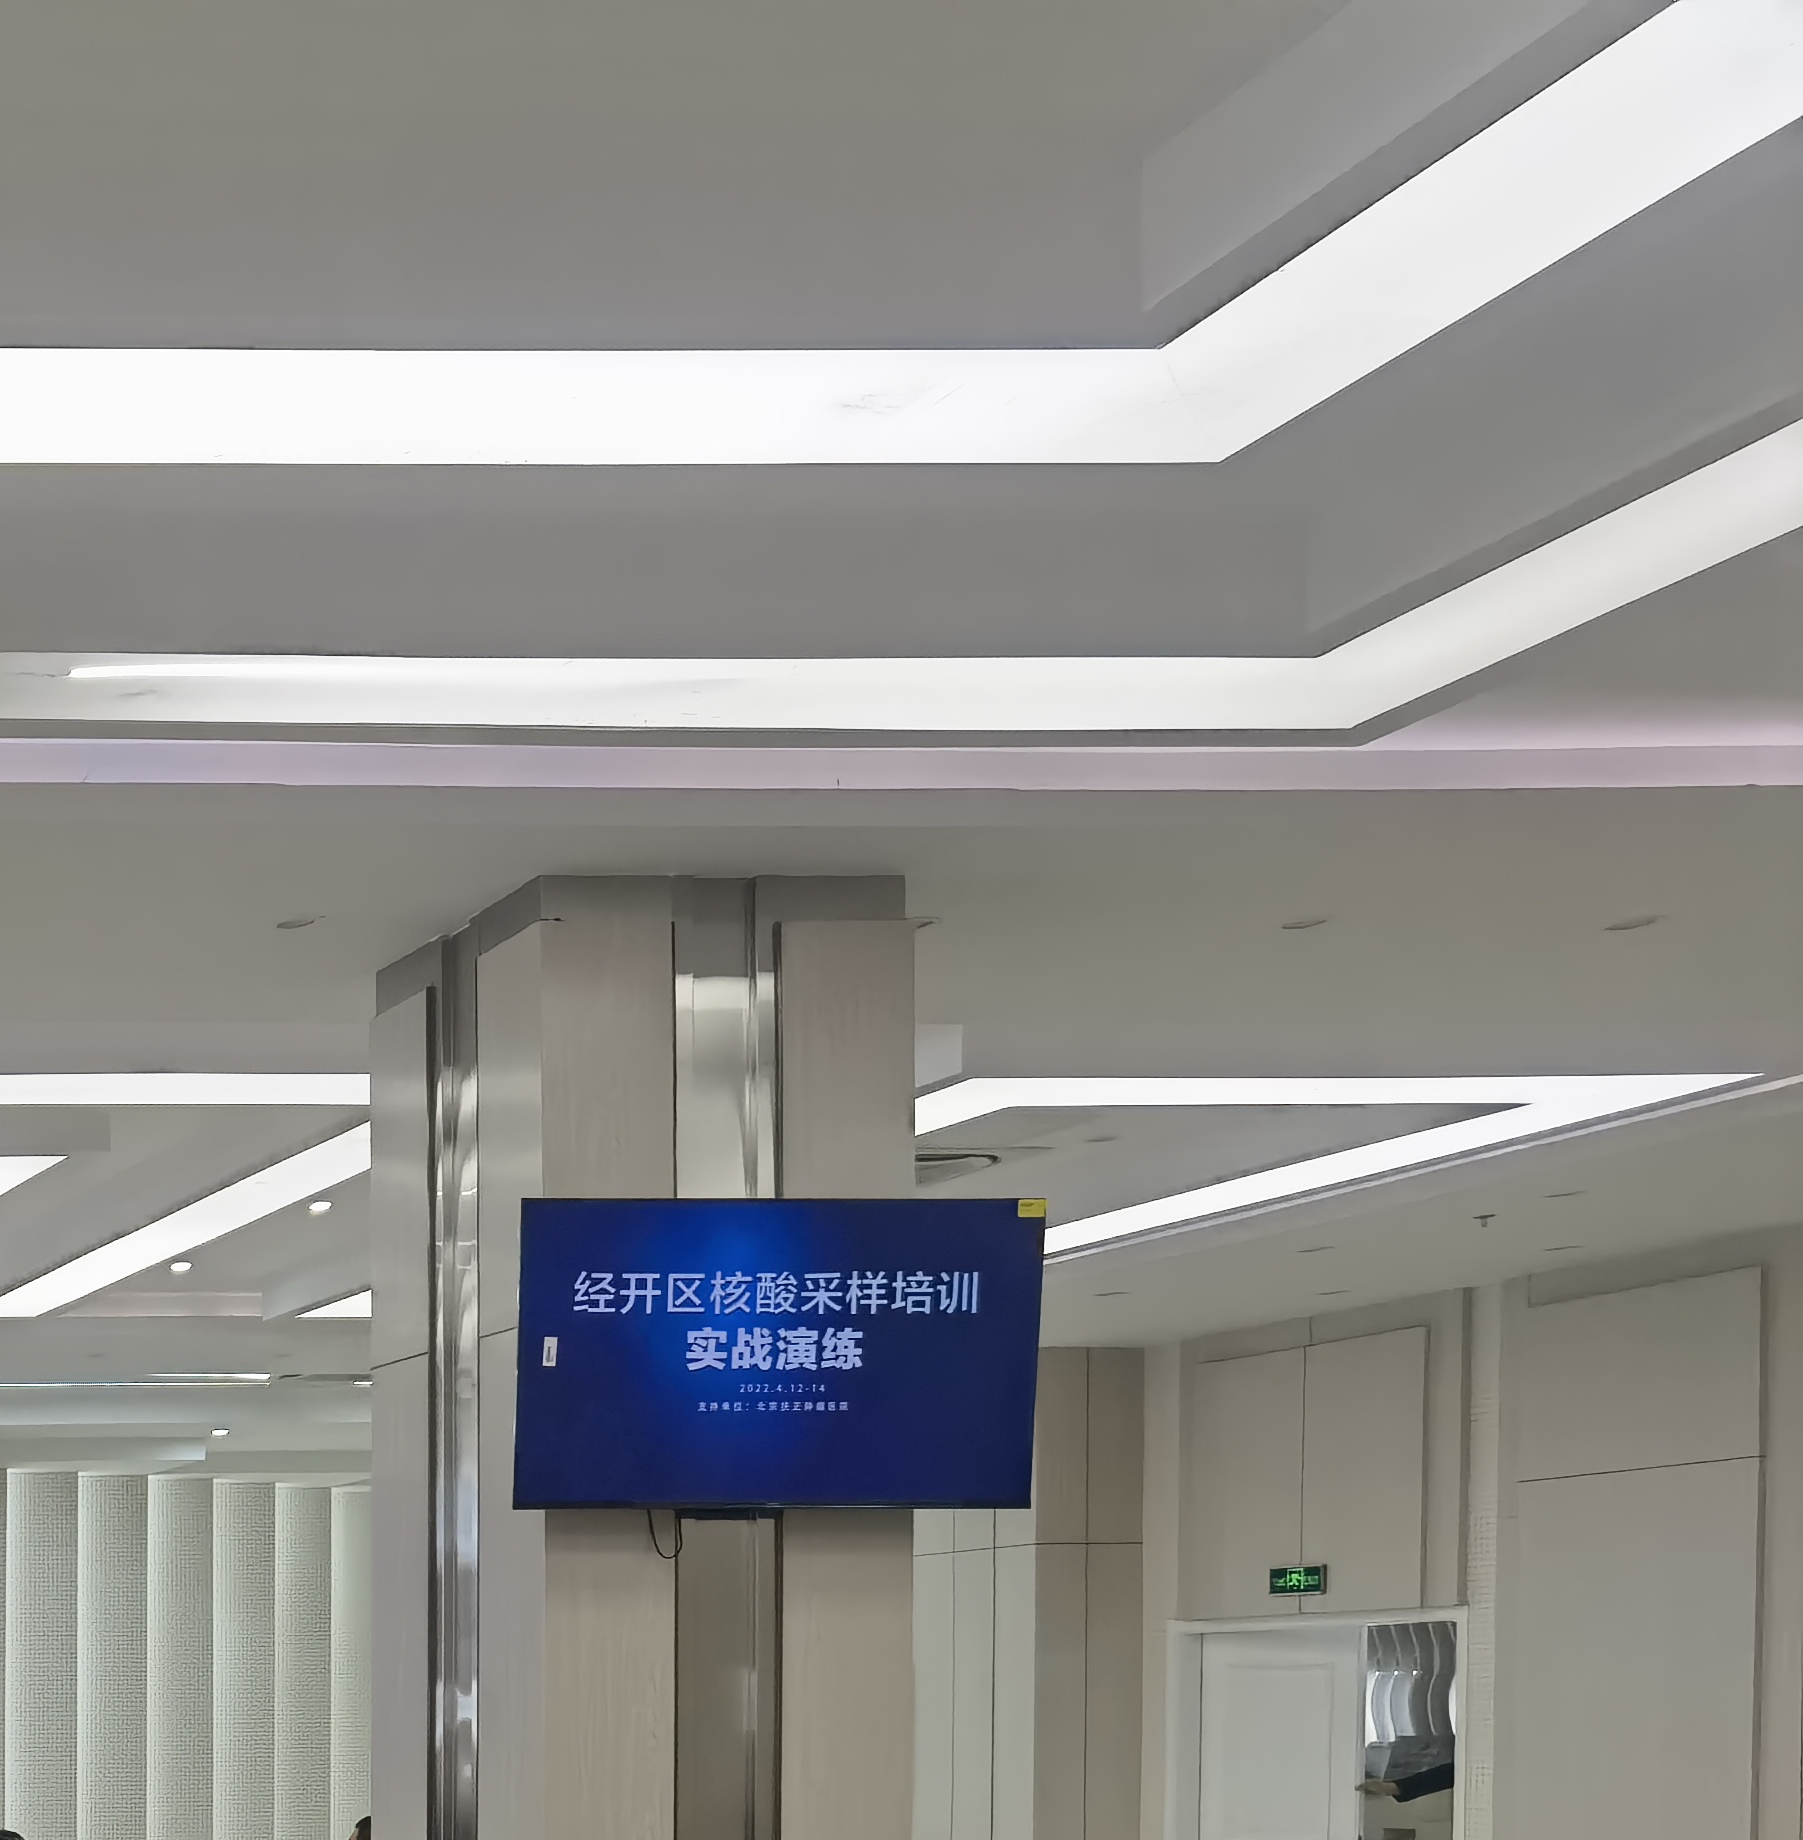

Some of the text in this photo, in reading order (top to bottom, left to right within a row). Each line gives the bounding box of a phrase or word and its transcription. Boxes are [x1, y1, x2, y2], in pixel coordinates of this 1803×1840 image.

[573, 1270, 979, 1316] 经开区核酸采样培训
[685, 1326, 864, 1372] 实战演练
[739, 1384, 826, 1393] 2022.4.12-14
